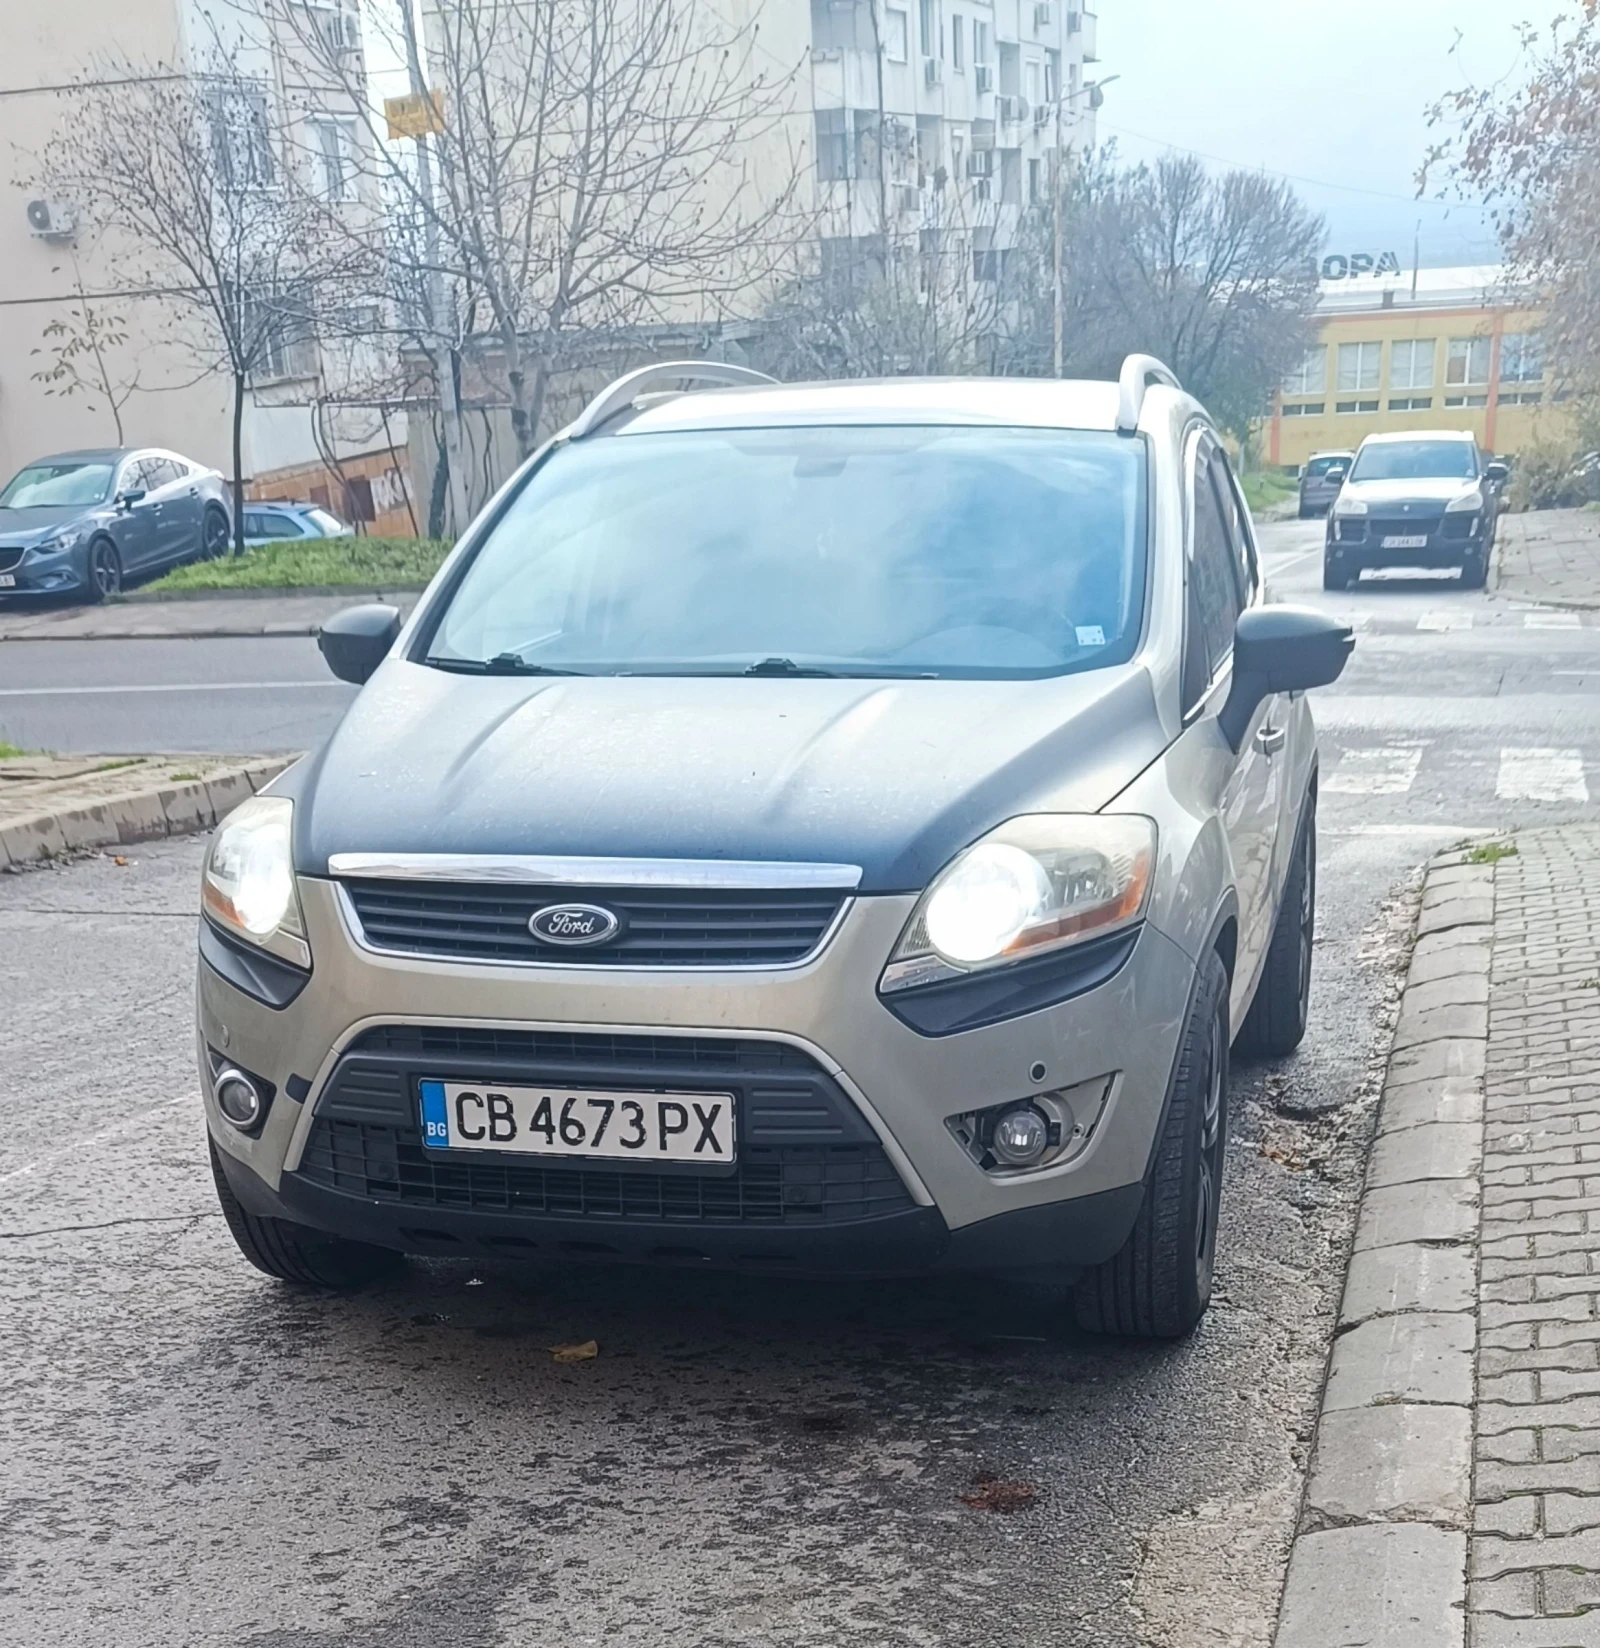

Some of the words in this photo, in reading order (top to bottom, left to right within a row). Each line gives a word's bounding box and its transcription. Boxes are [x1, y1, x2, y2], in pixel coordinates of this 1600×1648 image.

[548, 912, 595, 934] Ford
[427, 1121, 446, 1137] BG
[455, 1091, 517, 1142] CB
[529, 1096, 647, 1149] 4673
[657, 1101, 723, 1154] PX
